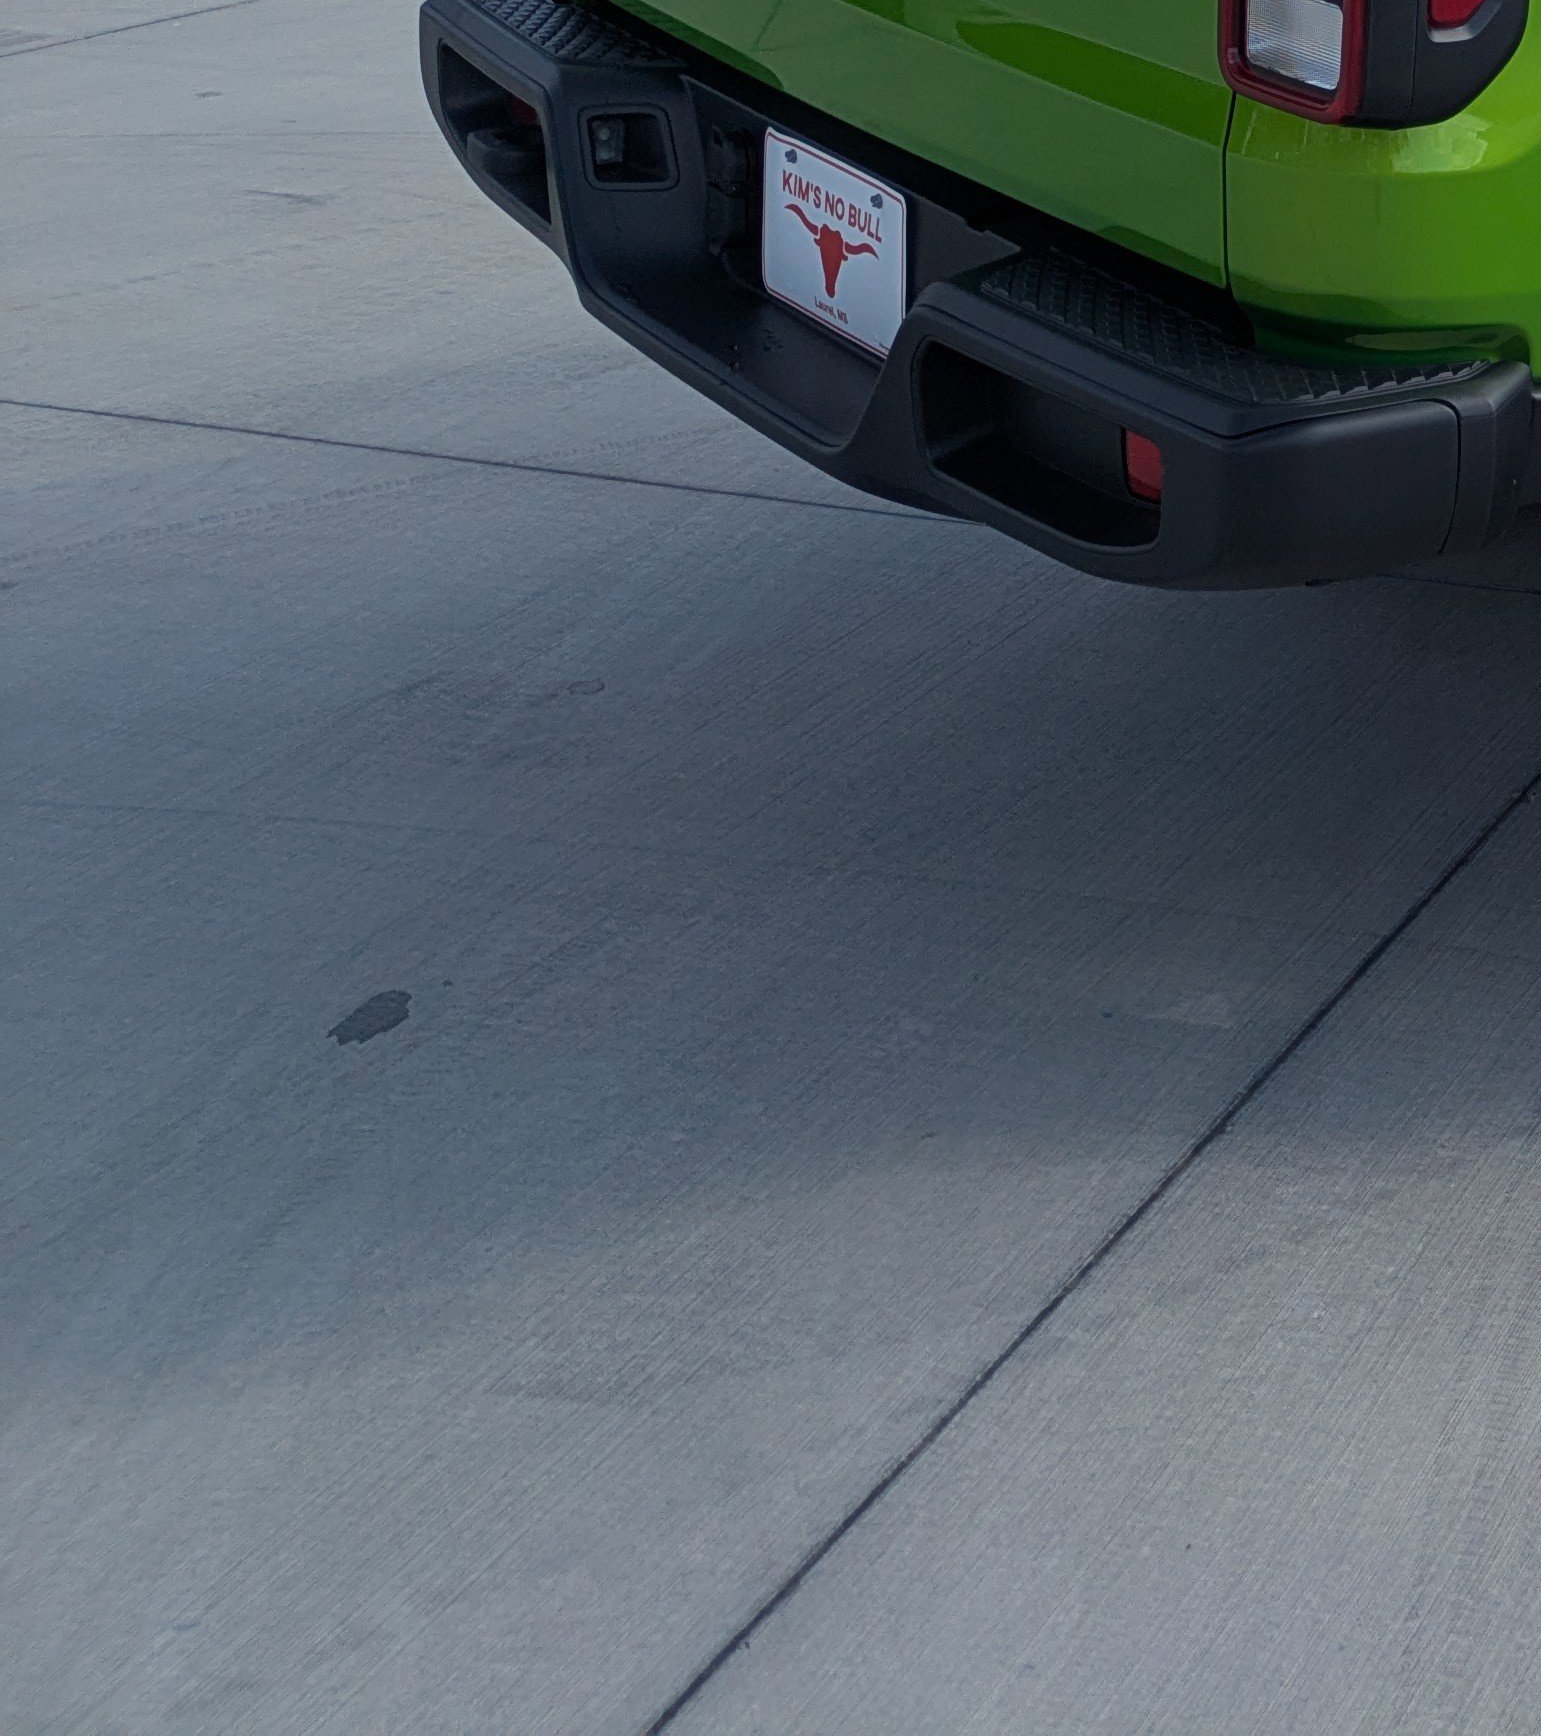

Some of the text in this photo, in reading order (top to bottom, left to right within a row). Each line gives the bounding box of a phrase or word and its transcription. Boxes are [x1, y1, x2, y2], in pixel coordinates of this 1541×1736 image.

[782, 169, 883, 244] KIM'S NO BULL
